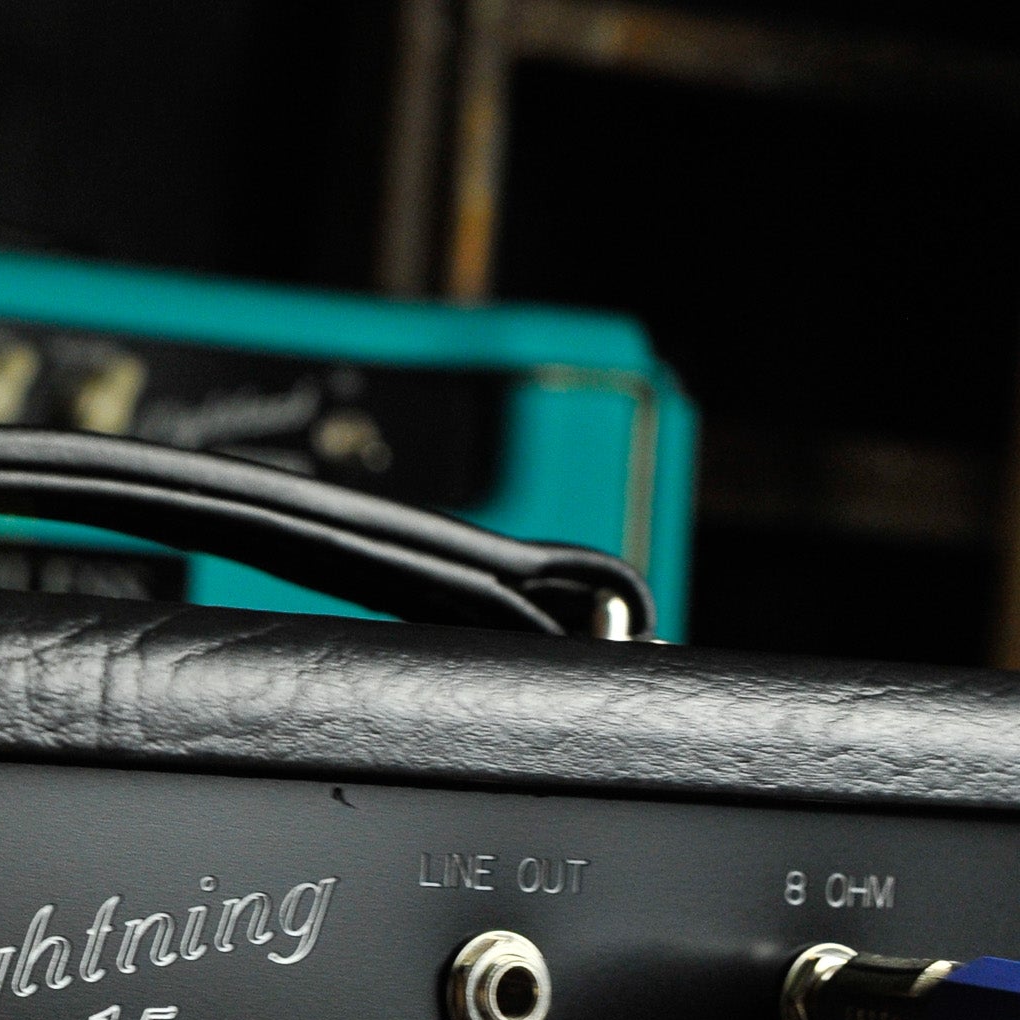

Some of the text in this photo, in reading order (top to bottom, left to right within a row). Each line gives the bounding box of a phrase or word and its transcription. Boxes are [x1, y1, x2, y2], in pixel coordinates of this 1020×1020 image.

[418, 852, 590, 896] LINE OUT
[784, 870, 897, 910] 8 OHM
